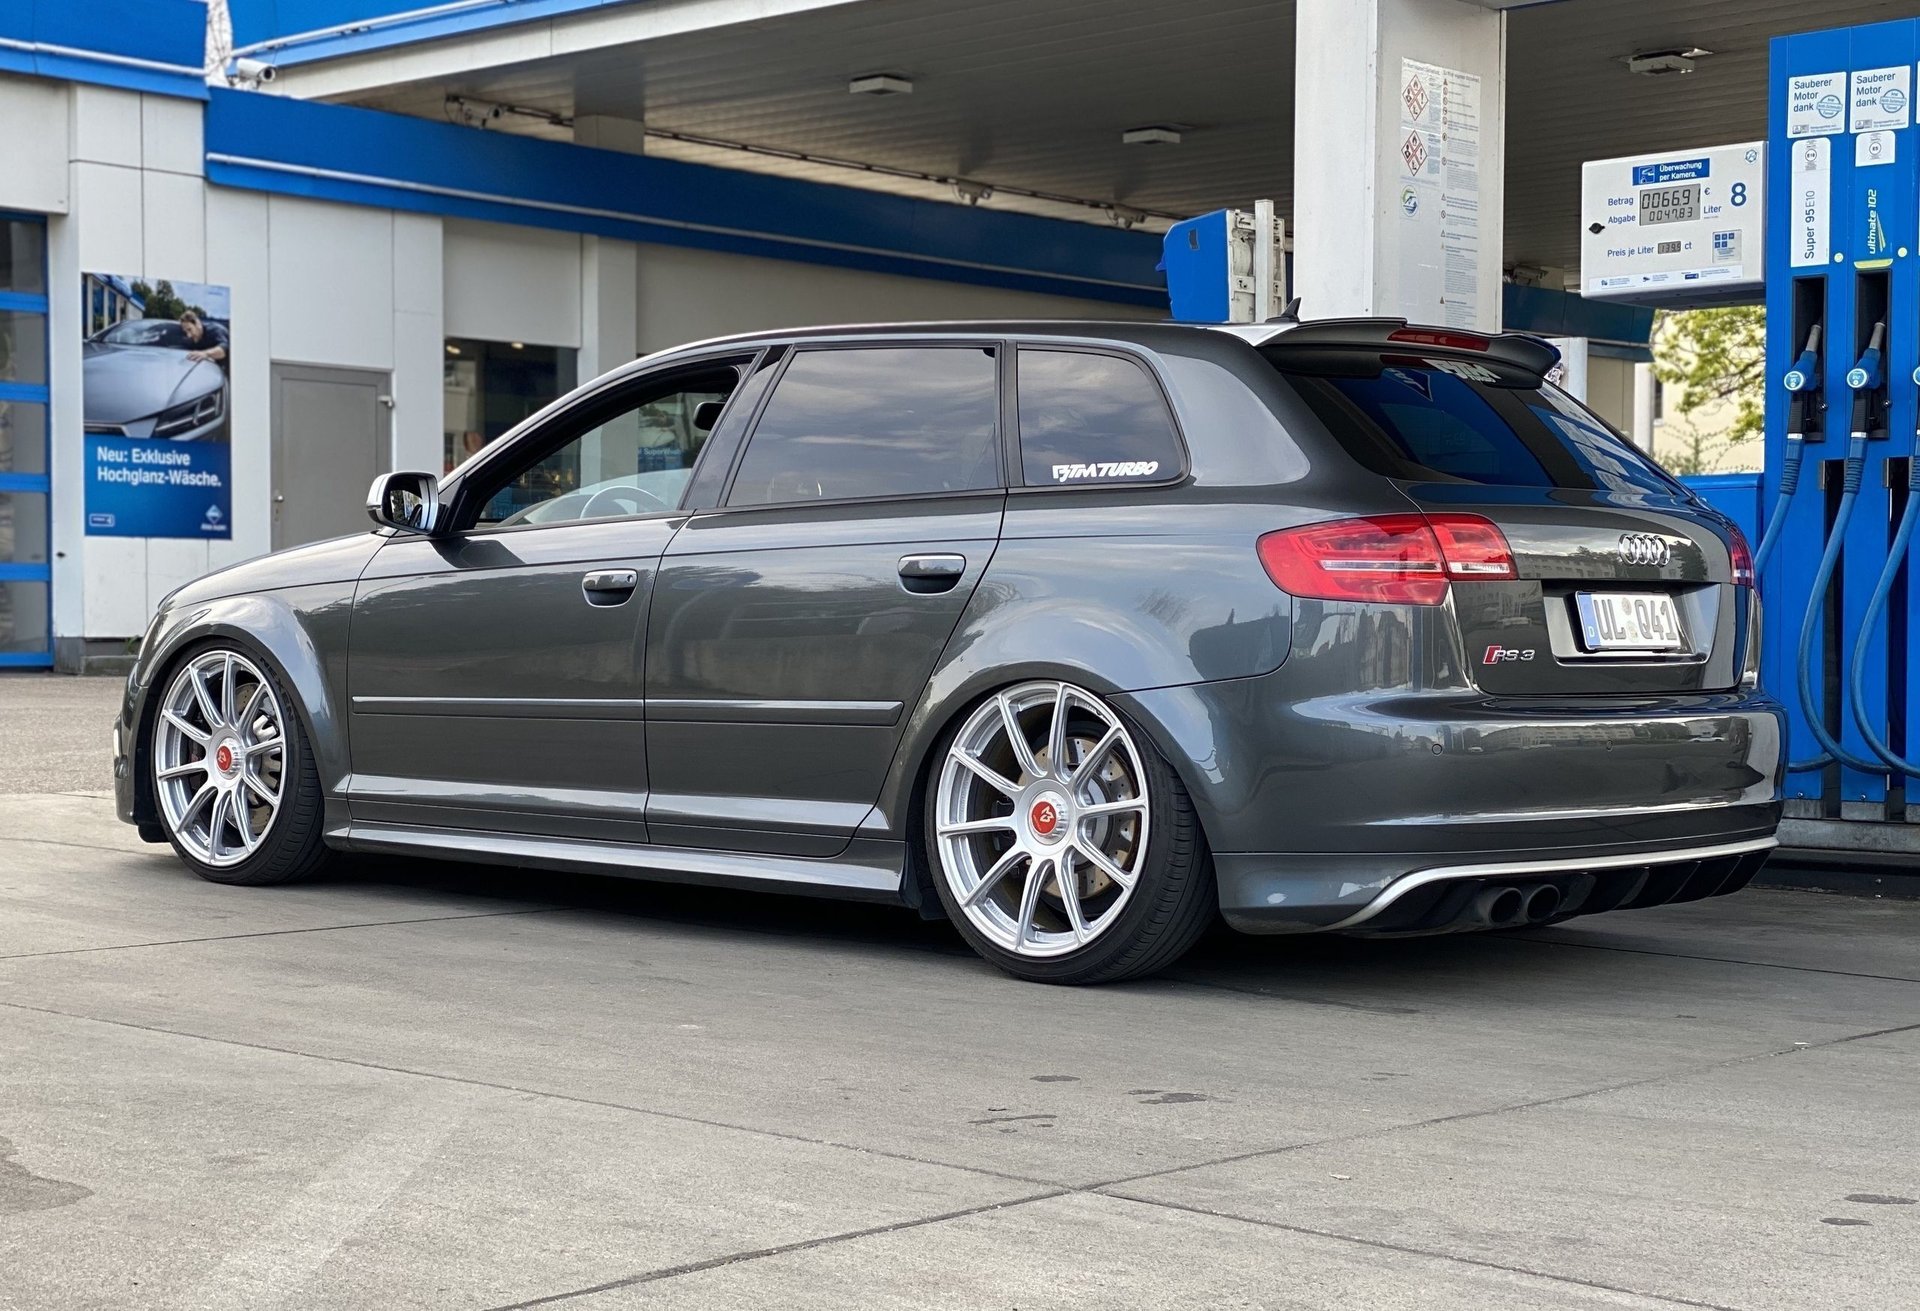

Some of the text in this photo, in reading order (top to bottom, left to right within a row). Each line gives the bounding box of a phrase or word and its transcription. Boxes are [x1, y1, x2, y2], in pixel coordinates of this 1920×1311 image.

[1794, 79, 1832, 89] Sauberer
[1856, 73, 1896, 84] Sauberer
[1794, 92, 1818, 100] Motor
[1856, 86, 1882, 95] Motor
[1793, 103, 1814, 112] dank
[1856, 97, 1877, 107] dank
[1660, 162, 1702, 172] Überwachung
[1660, 171, 1697, 182] per Kamera.
[1608, 197, 1633, 206] Betrag
[1704, 187, 1710, 195] €
[1731, 182, 1746, 206] 8
[1608, 214, 1636, 224] Abgabe
[1703, 205, 1722, 214] Liter
[1867, 189, 1877, 254] ultimate 102
[1805, 190, 1816, 259] Super 95 E10
[1607, 249, 1626, 257] Preis
[1628, 248, 1635, 257] je
[1637, 246, 1654, 254] Liter
[1684, 241, 1692, 250] ct
[97, 446, 191, 466] Neu: Exklusive
[97, 466, 222, 487] Hochglanz-Wäsche.
[1593, 599, 1678, 640] UL Q41
